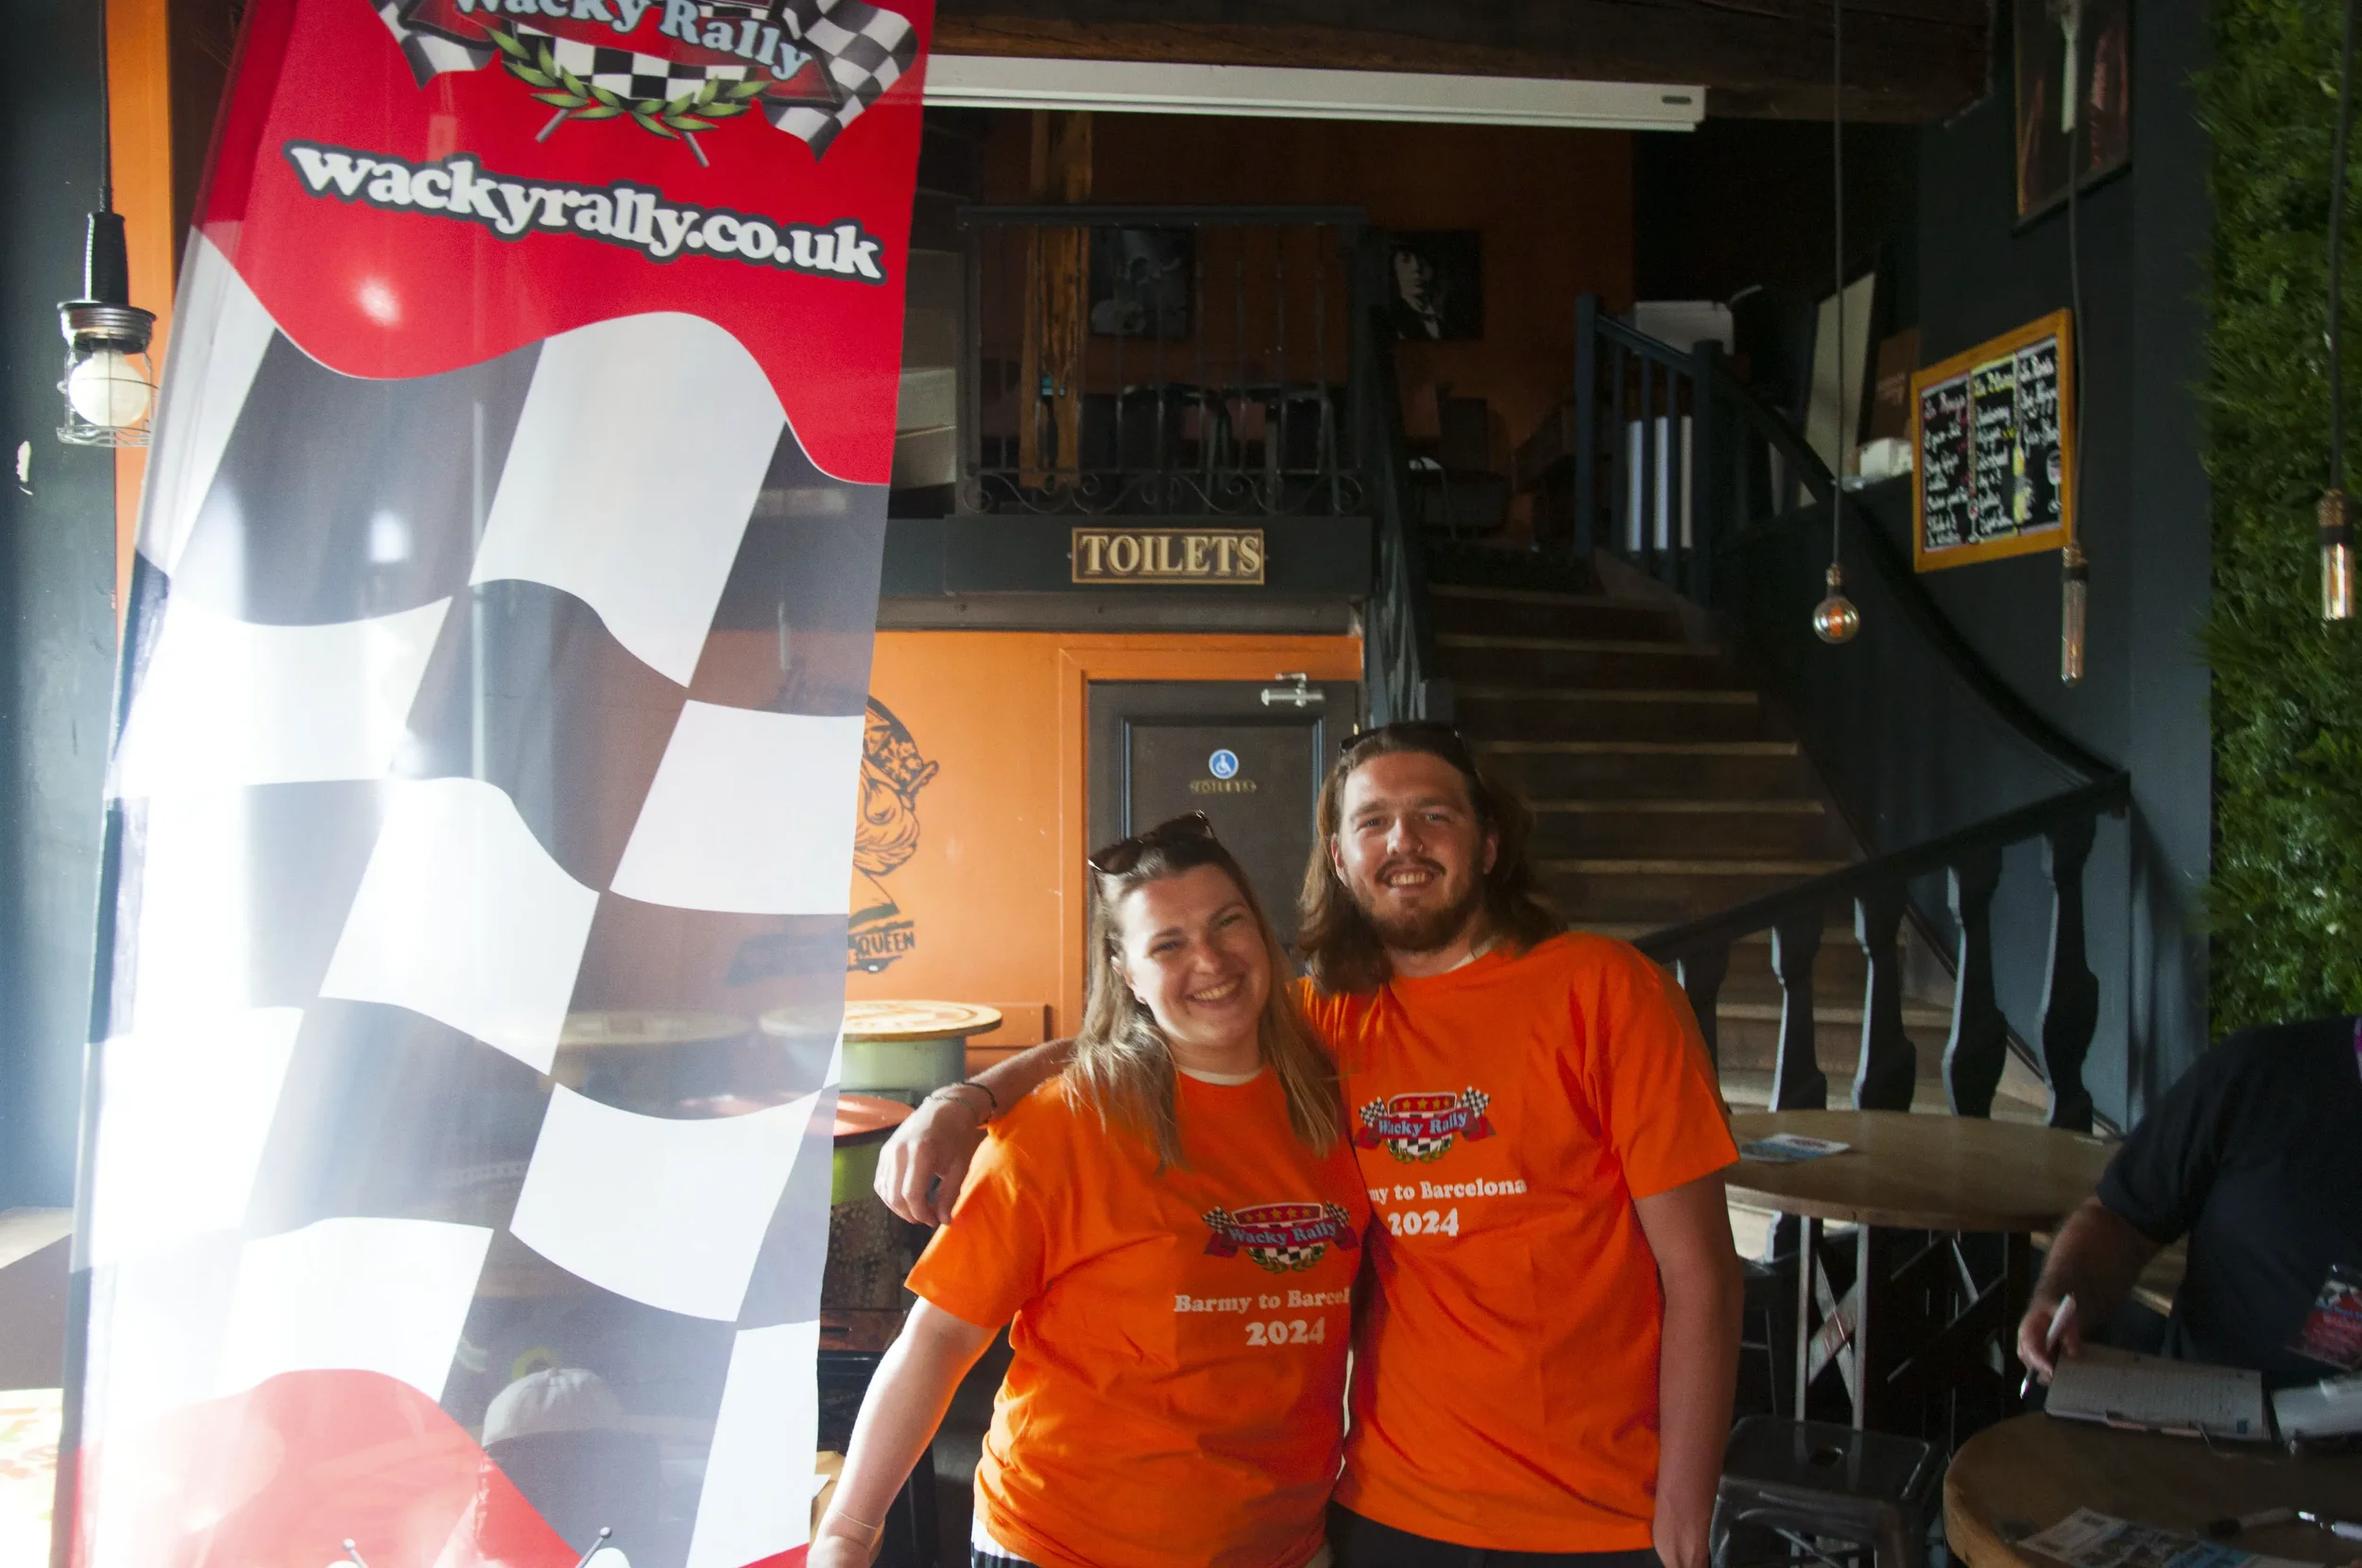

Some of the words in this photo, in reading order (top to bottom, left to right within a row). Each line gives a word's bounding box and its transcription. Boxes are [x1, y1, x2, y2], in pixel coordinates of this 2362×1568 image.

[659, 0, 813, 81] Rally
[290, 146, 881, 279] wackyrally.co.uk
[1079, 535, 1261, 575] TOILETS
[1378, 1117, 1424, 1137] Wacky
[1429, 1112, 1467, 1134] Rally
[1394, 1184, 1415, 1201] to
[1420, 1178, 1528, 1200] Barcelona
[1228, 1227, 1288, 1246] Wacky
[1291, 1221, 1336, 1242] Rally
[1388, 1208, 1460, 1236] 2024
[1173, 1294, 1252, 1314] Barmy
[1258, 1294, 1281, 1309] to
[1245, 1317, 1326, 1347] 2024
